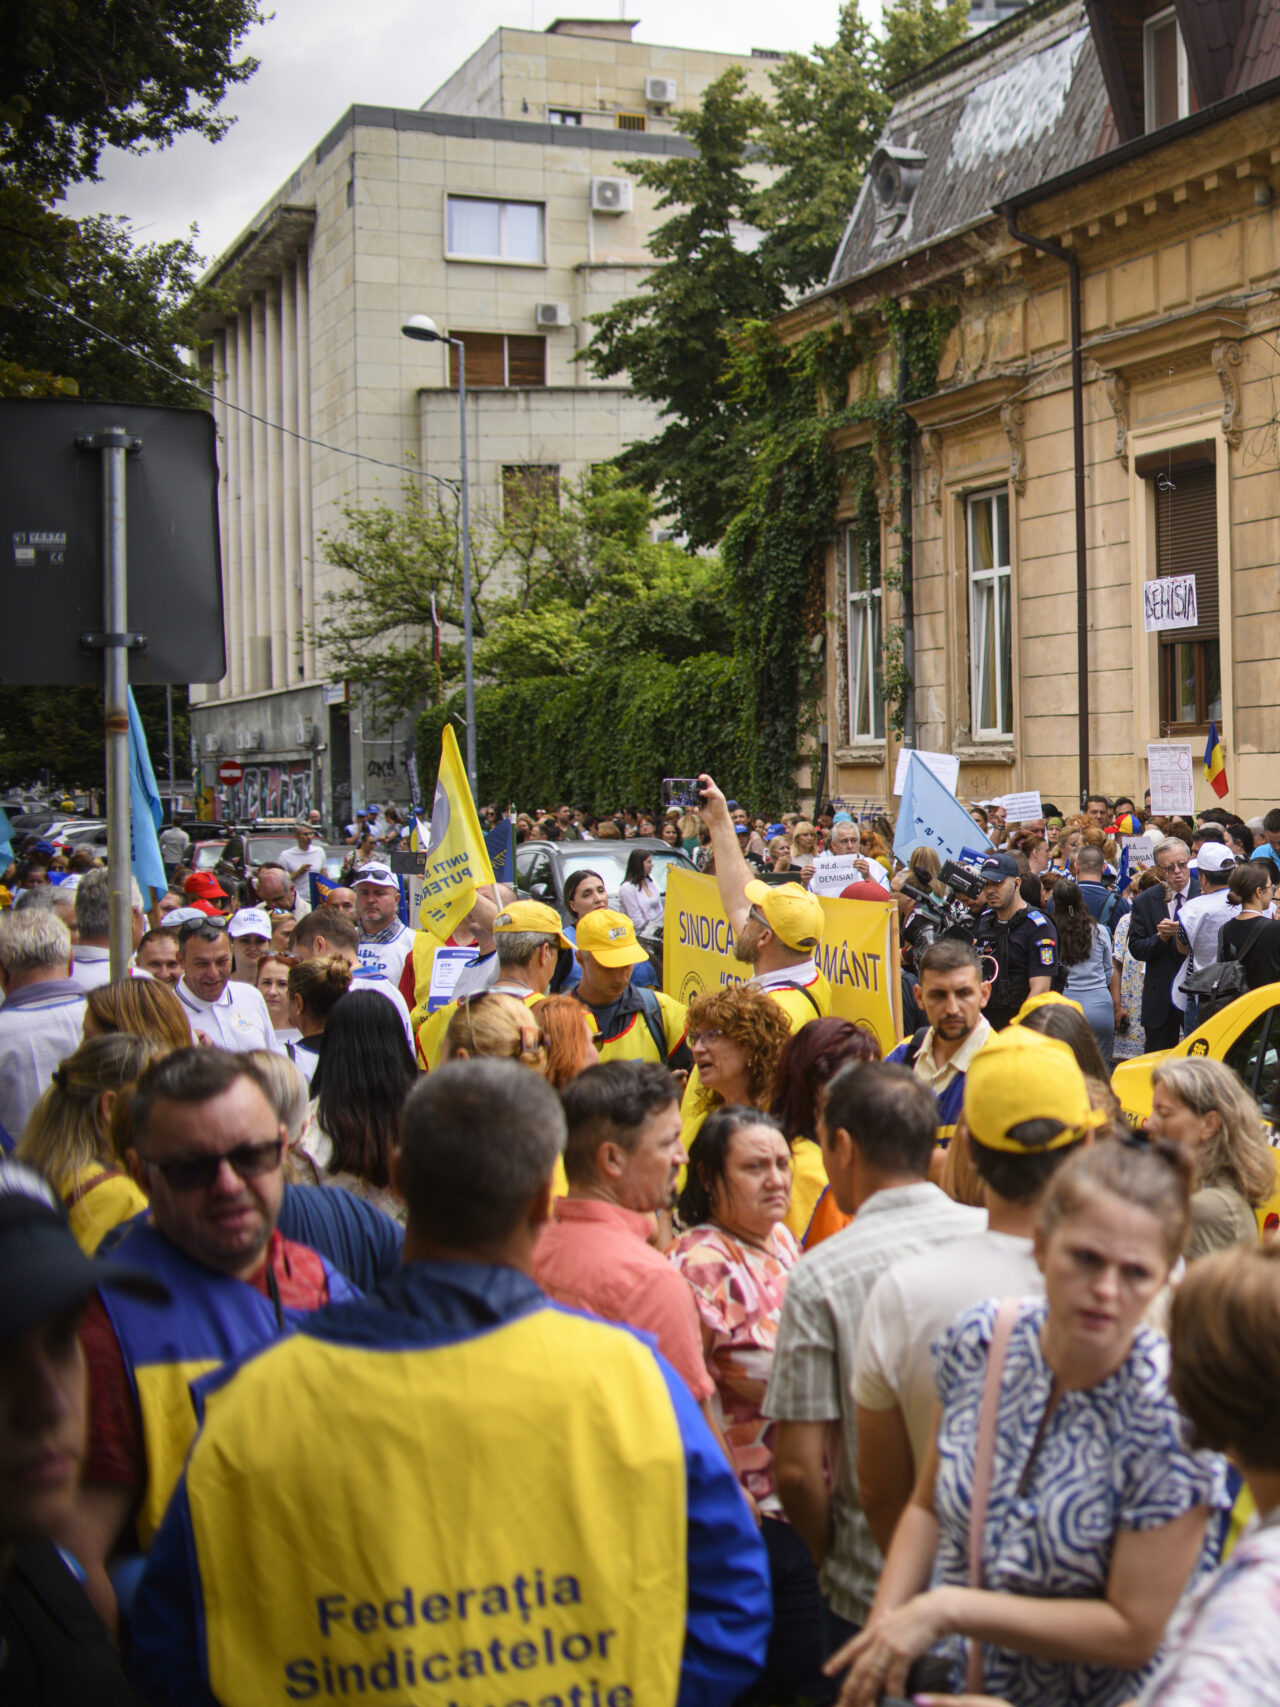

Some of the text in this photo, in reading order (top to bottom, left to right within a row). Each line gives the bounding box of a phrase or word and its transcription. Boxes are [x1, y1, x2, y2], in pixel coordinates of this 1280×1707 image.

[819, 873, 854, 883] DEMISIA!
[679, 910, 735, 956] SINDICA
[316, 1567, 582, 1637] Federația
[284, 1627, 616, 1700] Sindicatelor
